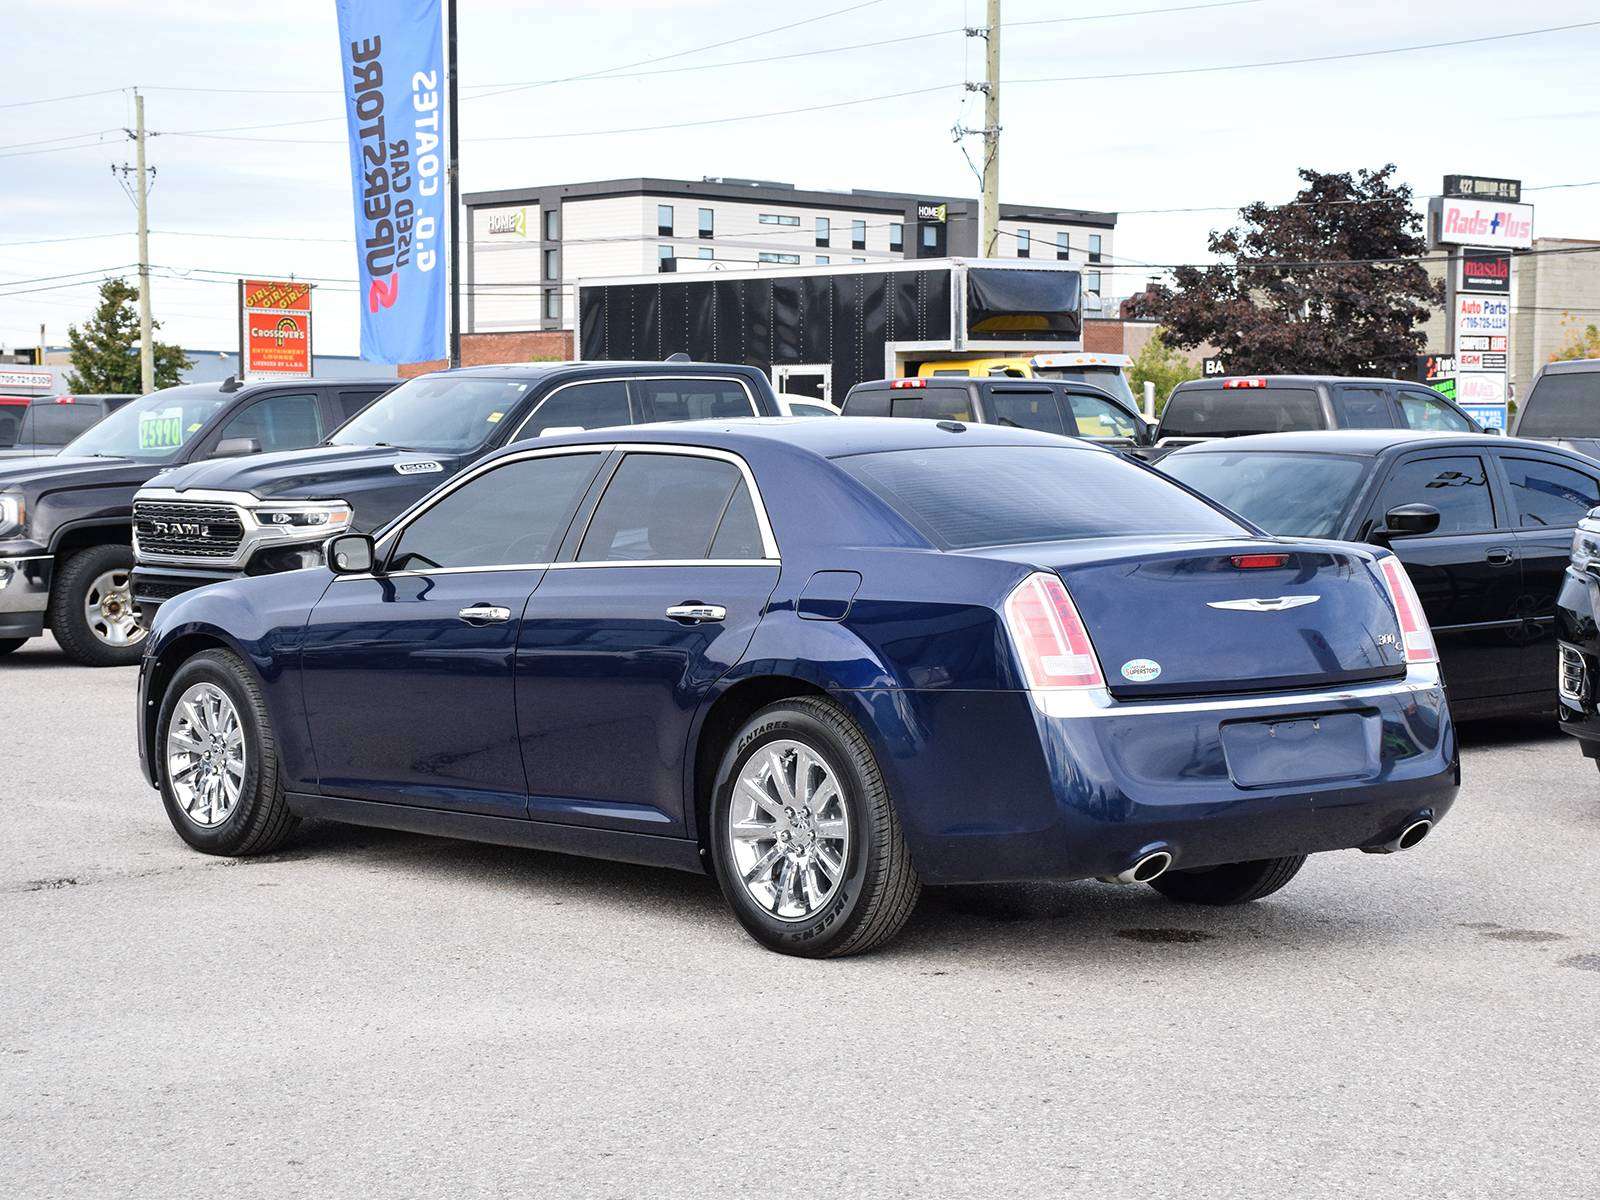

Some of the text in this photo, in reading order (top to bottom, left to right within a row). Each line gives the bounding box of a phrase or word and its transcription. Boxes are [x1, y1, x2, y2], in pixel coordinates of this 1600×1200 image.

[1445, 207, 1531, 239] Rads Plus
[1464, 258, 1508, 278] masala
[1461, 300, 1507, 315] Auto Parts
[1461, 355, 1480, 364] EGM
[152, 521, 200, 535] RAM
[737, 720, 790, 755] ANTARES
